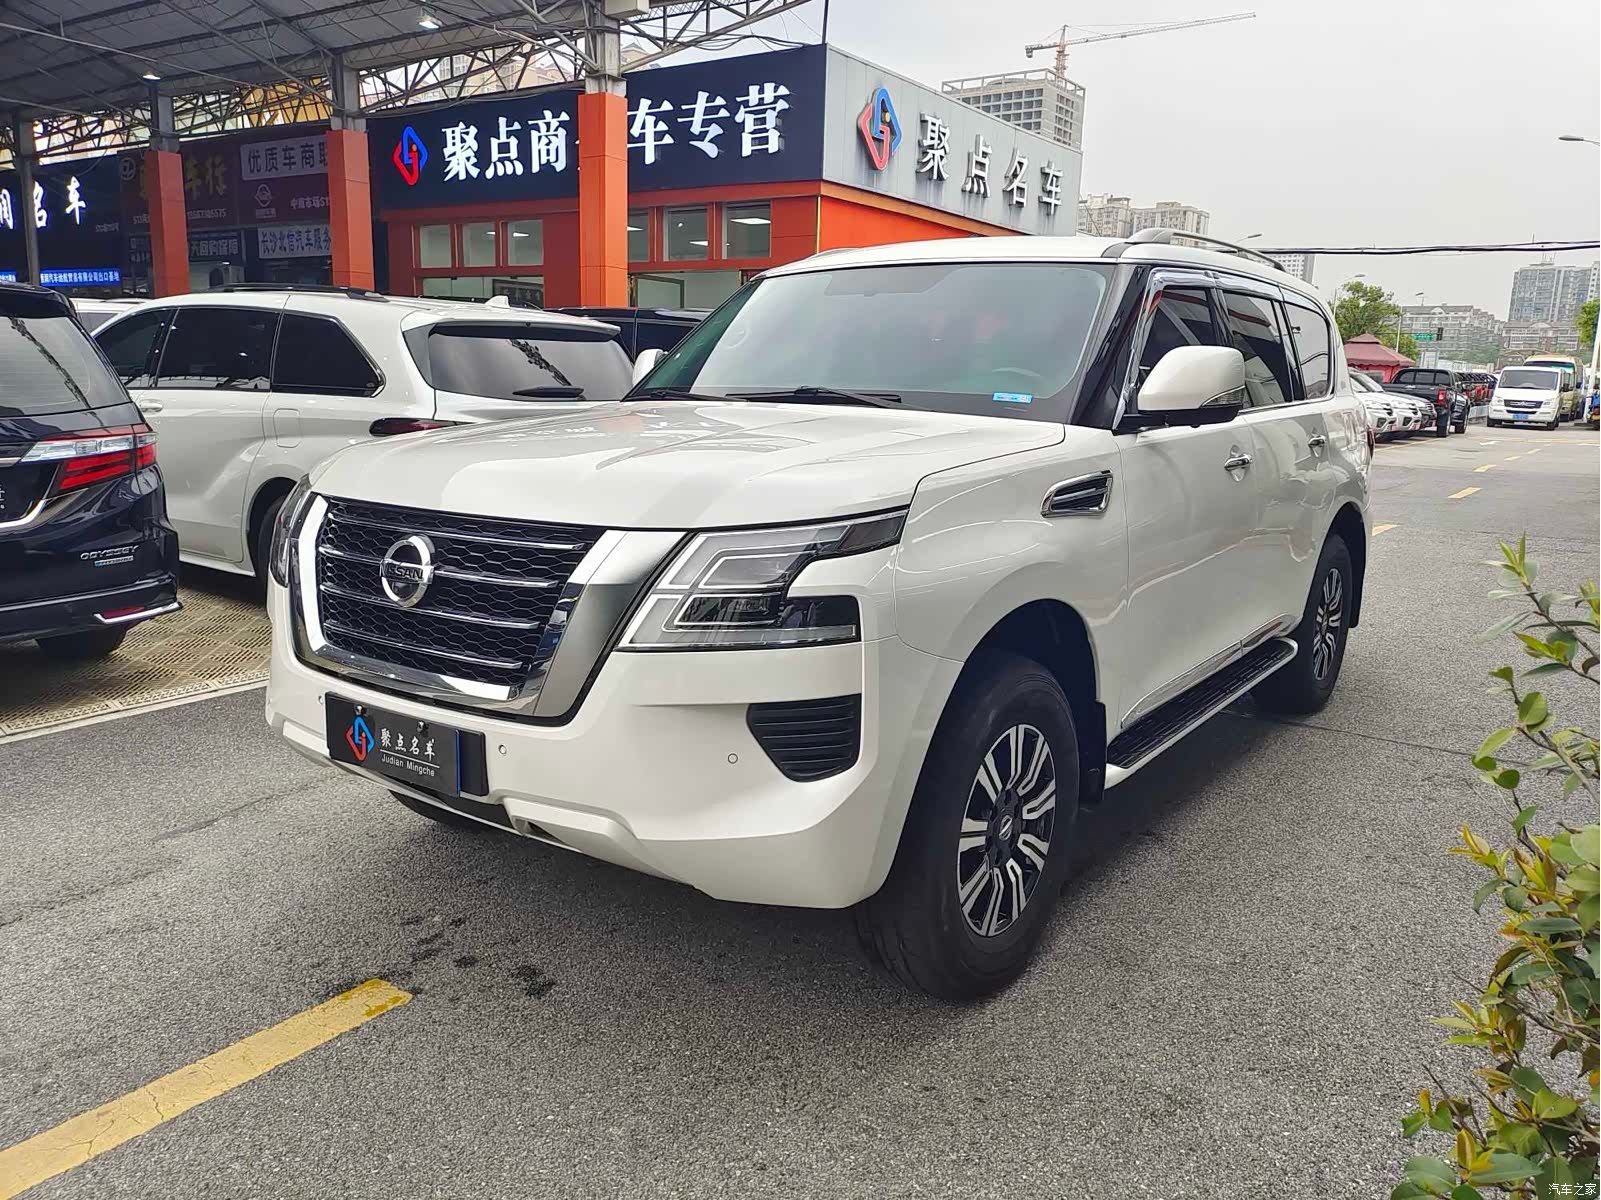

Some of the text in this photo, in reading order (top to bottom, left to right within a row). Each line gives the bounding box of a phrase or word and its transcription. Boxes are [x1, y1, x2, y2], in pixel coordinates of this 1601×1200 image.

[442, 82, 793, 182] 聚点商车专营
[915, 111, 1064, 215] 聚点名车
[81, 545, 139, 560] ODYSSEY
[380, 561, 425, 582] NISSAN
[381, 728, 436, 762] 聚点名车
[382, 754, 435, 777] Judian Mingche
